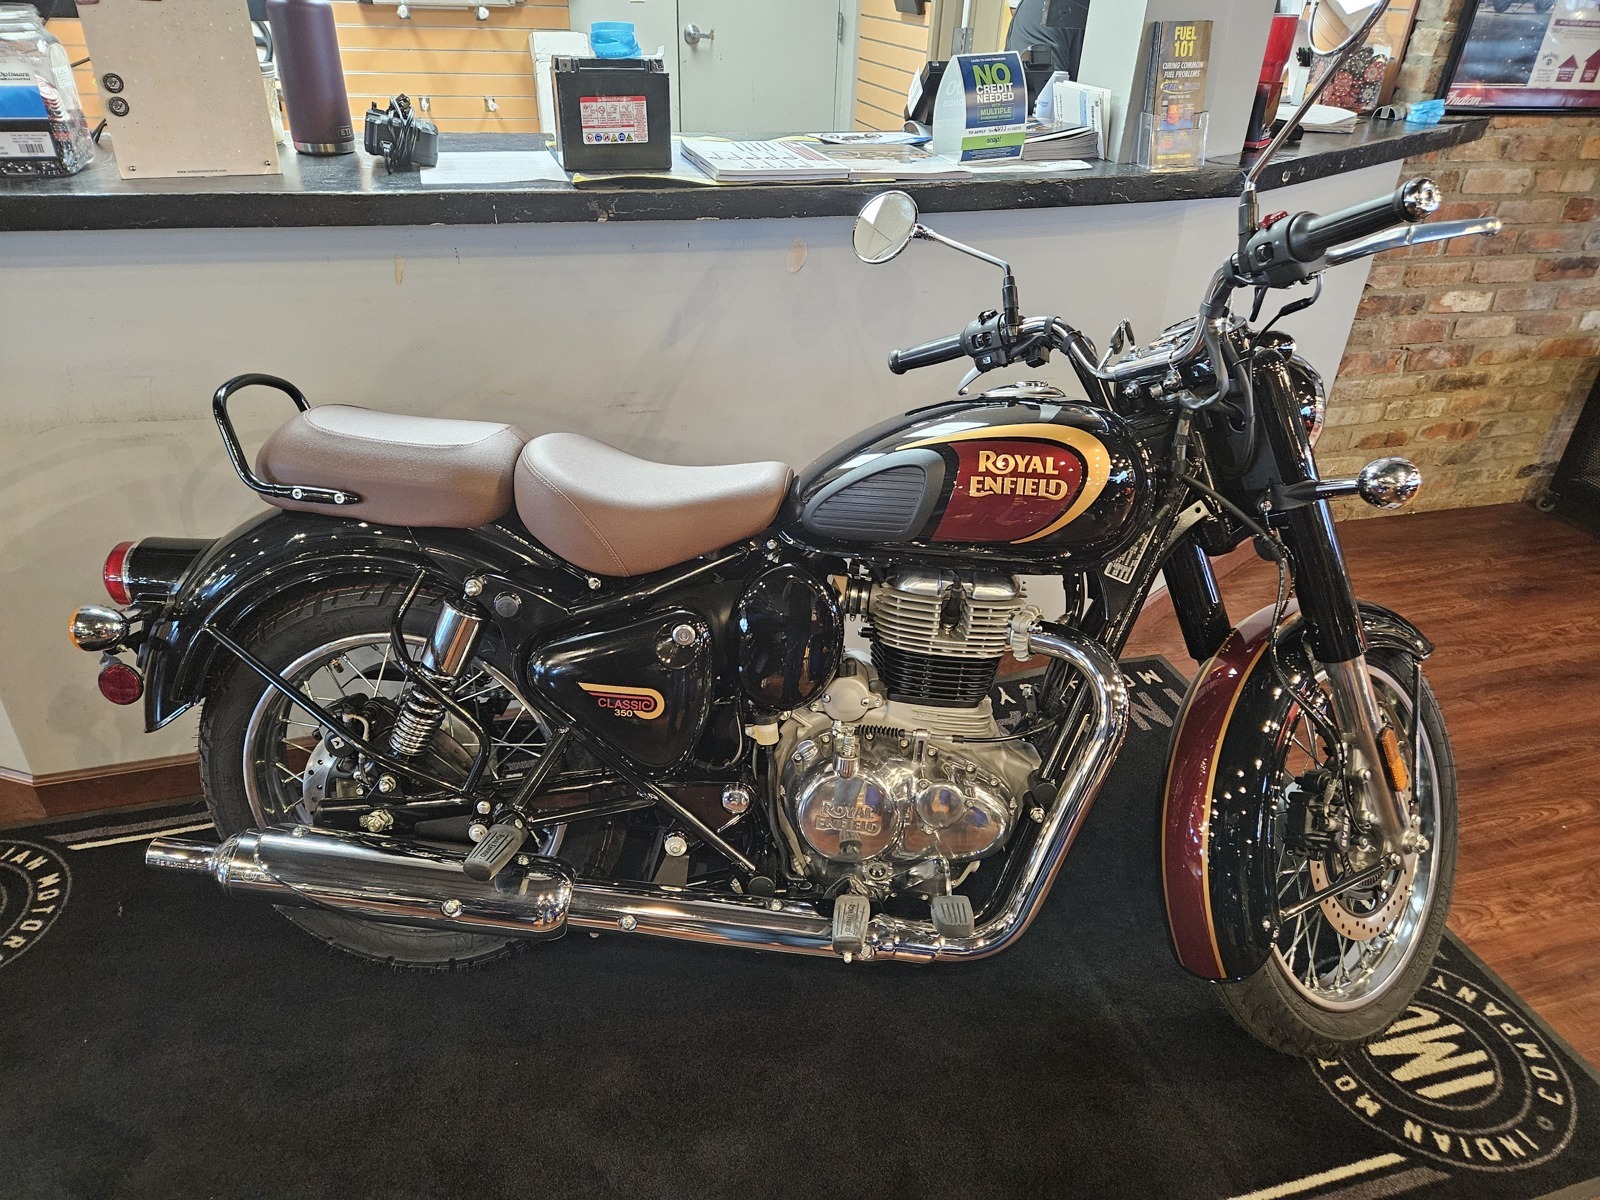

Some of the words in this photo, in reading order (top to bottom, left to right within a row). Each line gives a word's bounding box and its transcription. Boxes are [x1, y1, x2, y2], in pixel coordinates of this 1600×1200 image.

[1175, 26, 1197, 40] FUEL
[1174, 41, 1194, 58] 101
[1162, 62, 1181, 70] CURING
[1181, 61, 1204, 69] COMMON
[972, 62, 1011, 86] NO
[1164, 71, 1175, 79] FUEL
[1175, 70, 1200, 78] PROBLEMS
[976, 83, 1013, 94] CREDIT
[977, 92, 1014, 103] NEEDED
[1444, 90, 1482, 105] Indian
[980, 106, 1012, 116] MULTIPLE
[978, 450, 1059, 475] ROYAL
[969, 476, 1068, 501] ENFIELD
[597, 697, 655, 711] CLASSIC
[614, 708, 633, 717] 350
[821, 800, 877, 819] ROYAL
[815, 815, 882, 836] ENFIELD
[1431, 974, 1565, 1107] COMPANY
[1402, 1118, 1541, 1162] INDIAN
